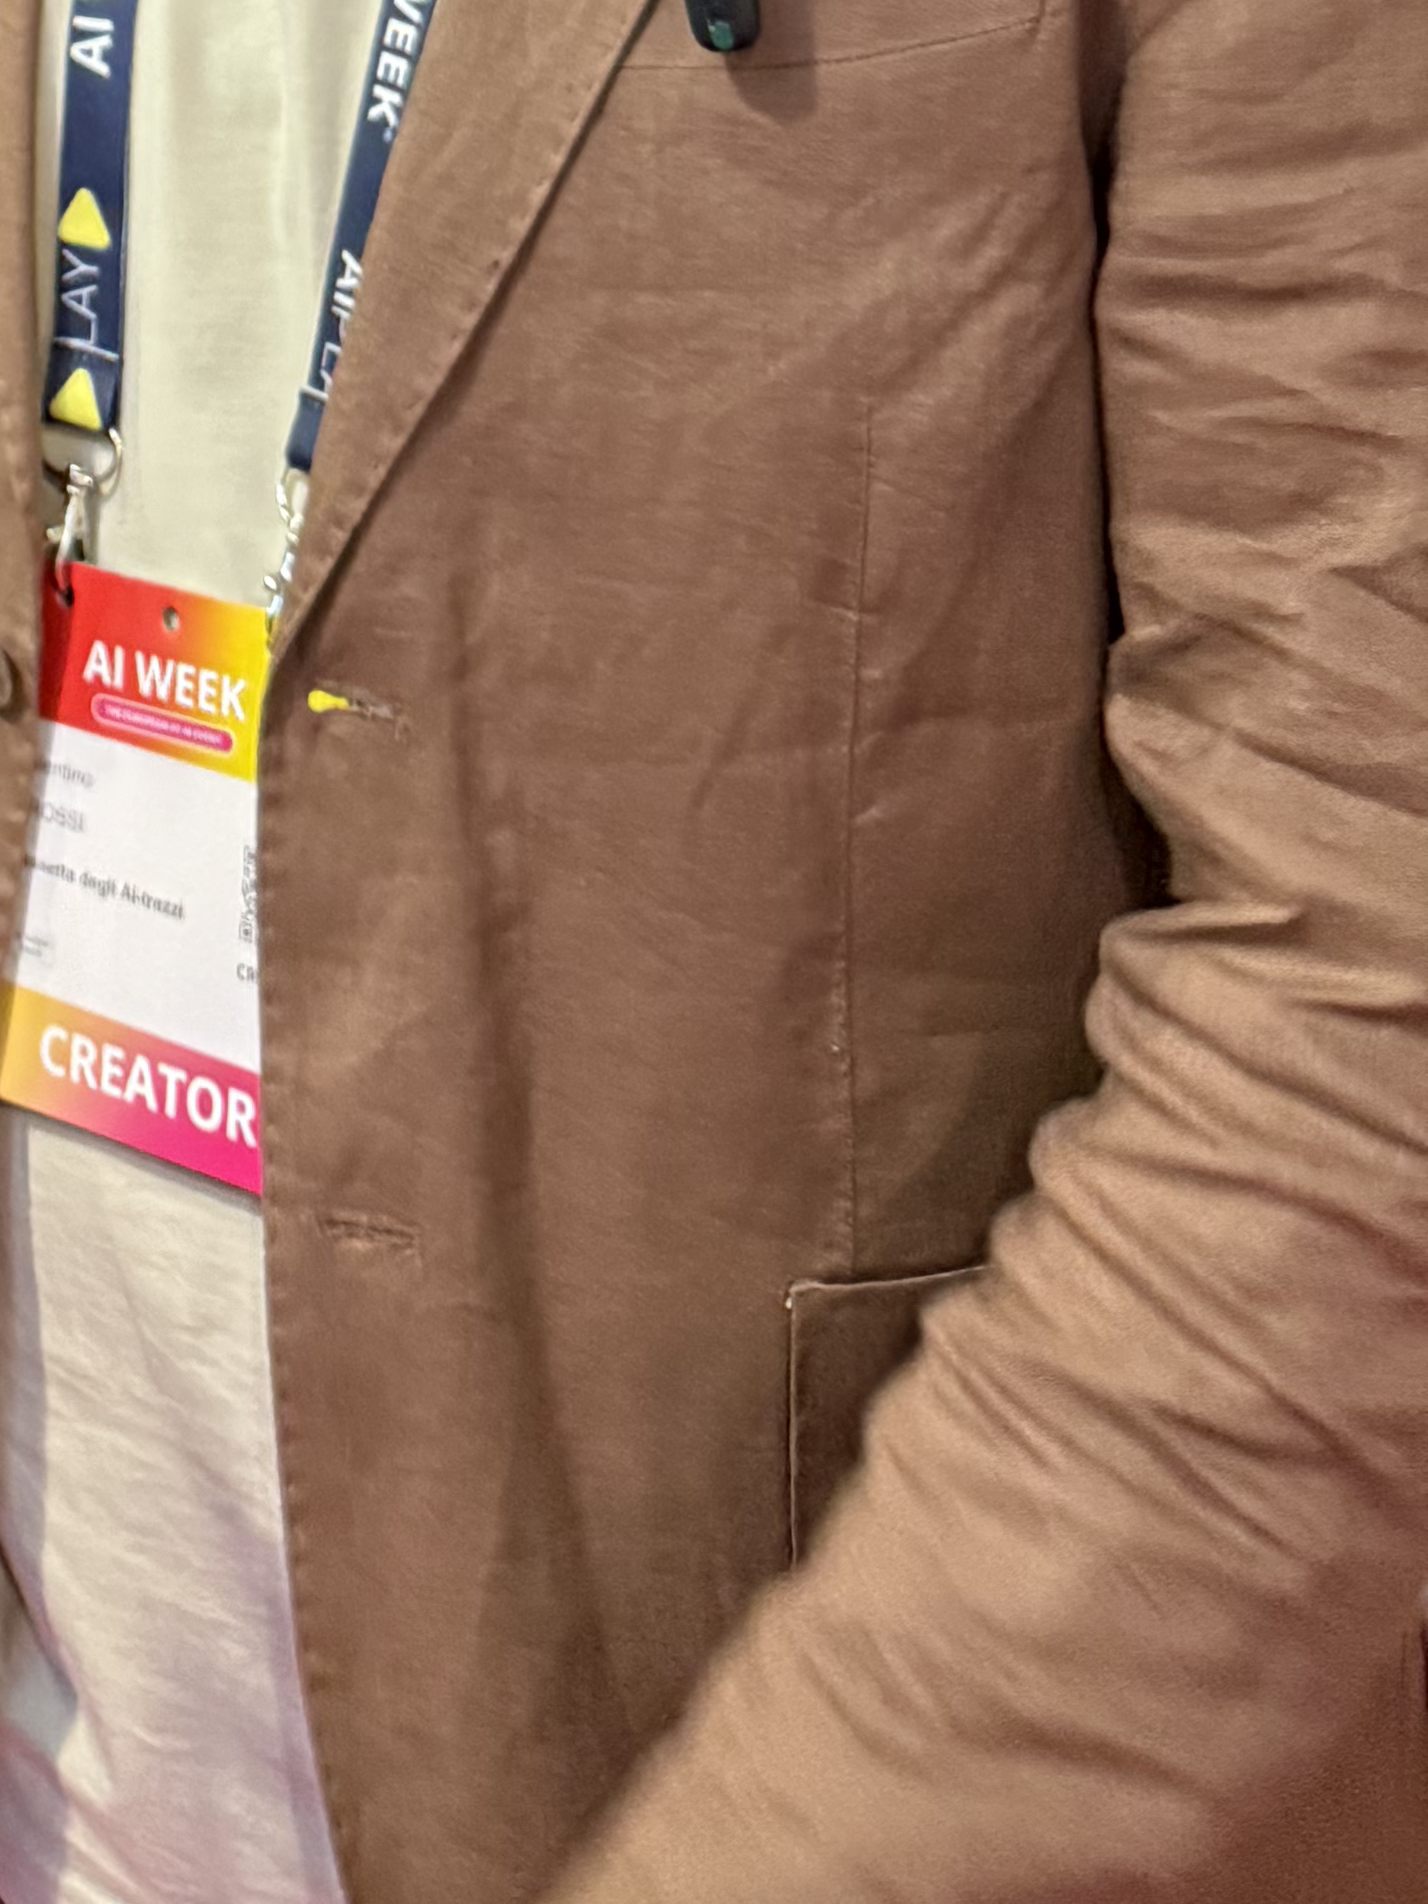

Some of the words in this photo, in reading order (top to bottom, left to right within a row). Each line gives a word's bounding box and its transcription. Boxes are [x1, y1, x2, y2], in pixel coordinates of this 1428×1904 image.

[70, 15, 114, 79] AI
[82, 639, 125, 691] AI
[134, 649, 246, 722] WEEK
[39, 1022, 257, 1149] CREATOR
